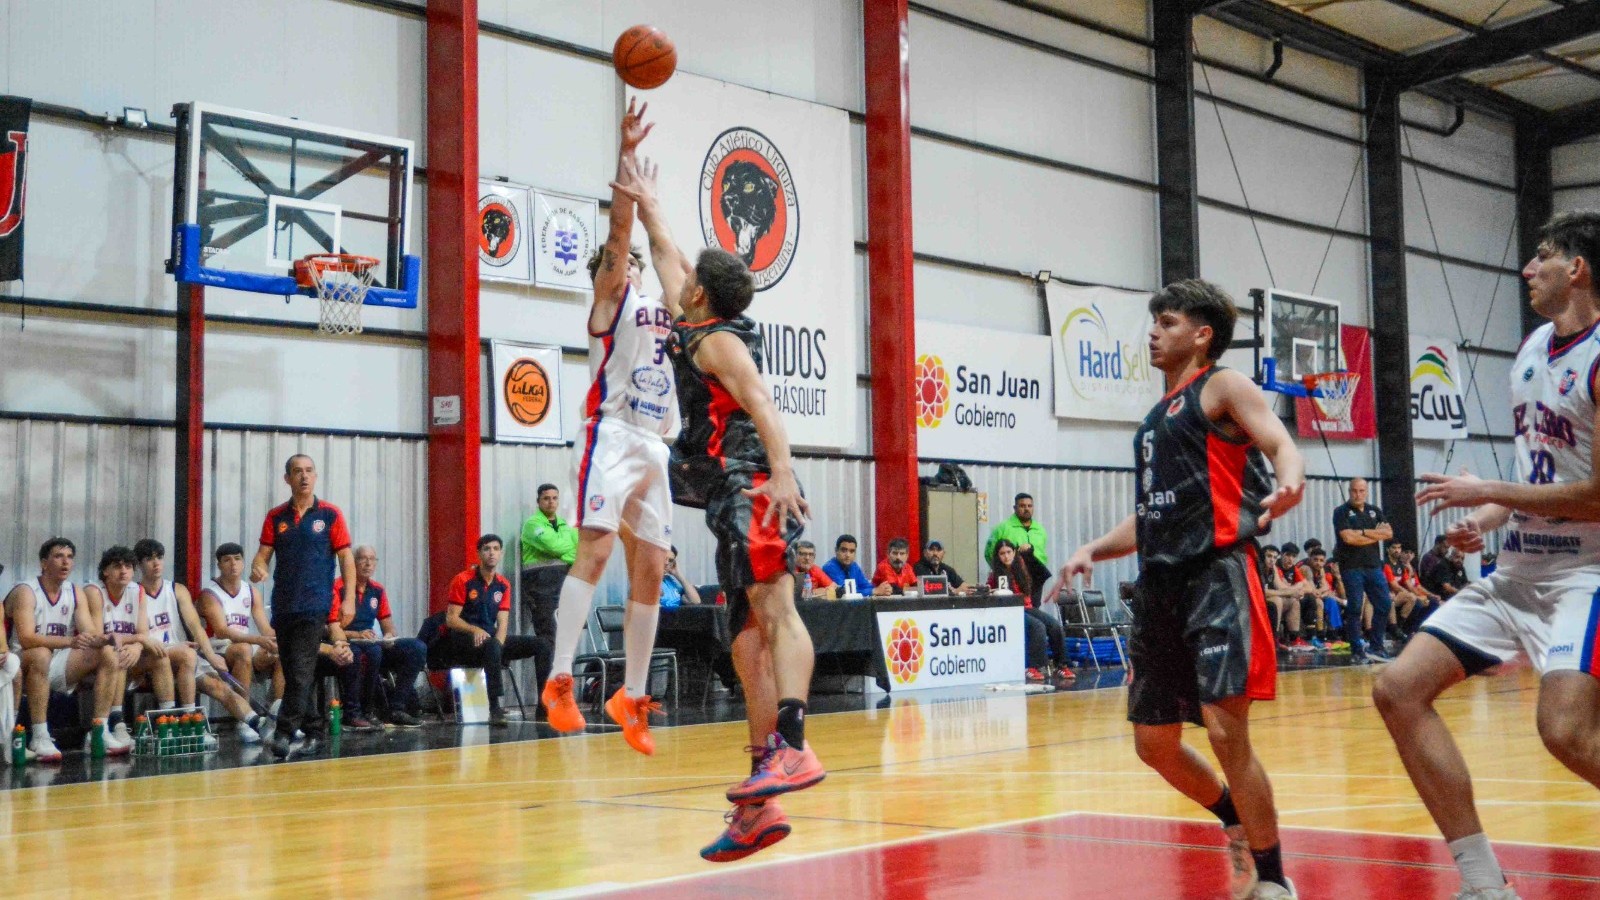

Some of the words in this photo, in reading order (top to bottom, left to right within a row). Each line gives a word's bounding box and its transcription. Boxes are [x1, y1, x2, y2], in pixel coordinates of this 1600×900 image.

[703, 155, 718, 191] Club
[720, 132, 762, 157] Atlético
[765, 145, 796, 207] Urquiza
[541, 209, 558, 254] FEDERACN
[653, 337, 667, 366] 3
[758, 322, 827, 381] NIDOS
[1079, 340, 1151, 382] HardSell
[773, 378, 827, 417] BÁSQUET
[956, 364, 991, 395] San
[996, 370, 1040, 400] Juan
[955, 402, 1016, 429] Gobierno
[1142, 429, 1155, 462] 5
[1000, 577, 1007, 590] 2
[930, 622, 962, 648] San
[966, 621, 1007, 645] Juan
[930, 653, 986, 676] Gobierno
